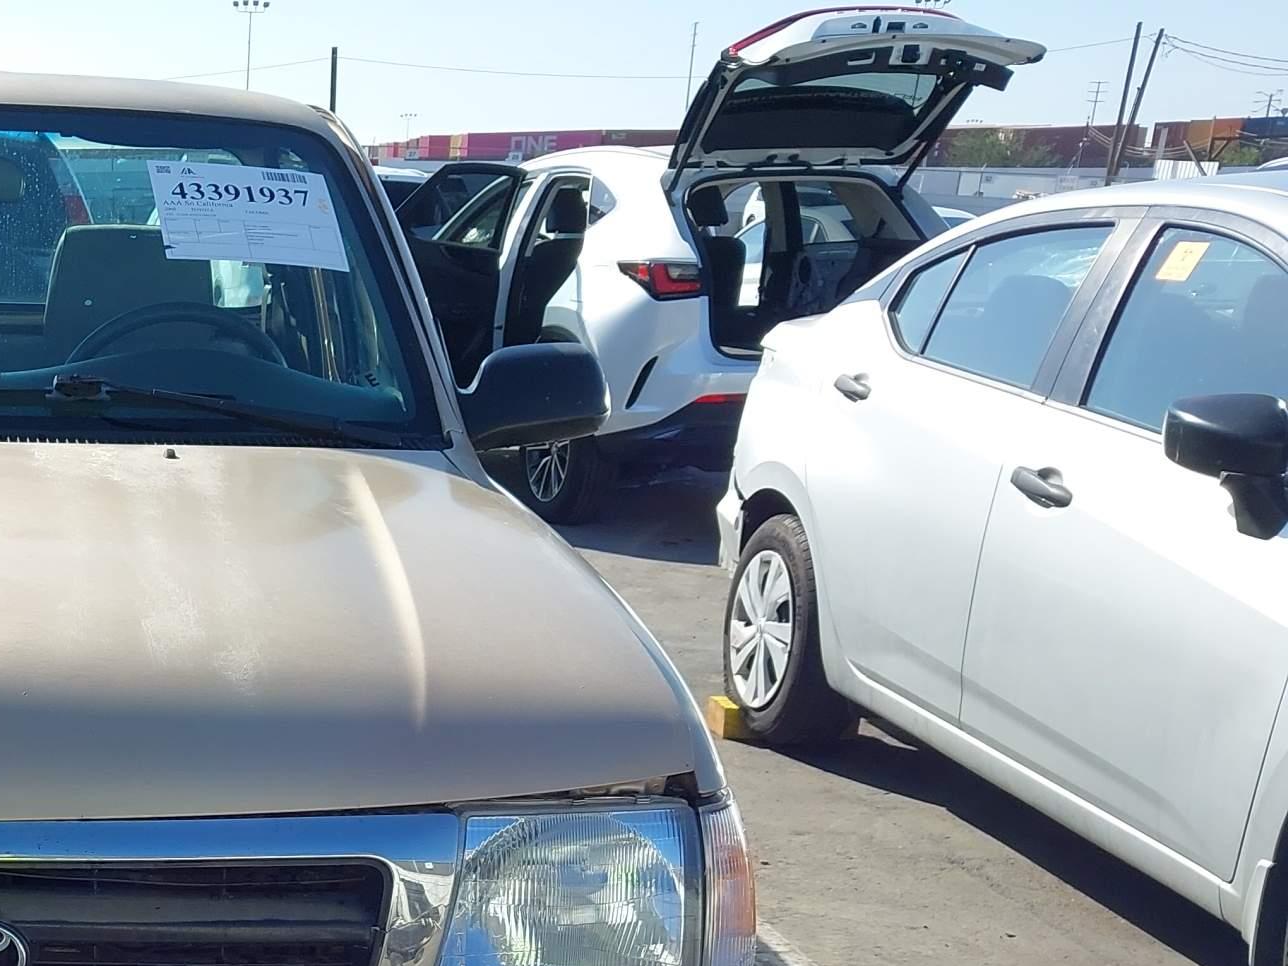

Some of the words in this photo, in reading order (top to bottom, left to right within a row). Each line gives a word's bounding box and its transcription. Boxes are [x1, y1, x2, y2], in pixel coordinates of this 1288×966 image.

[511, 135, 558, 153] ONE
[171, 181, 309, 207] 43391937
[196, 200, 234, 208] California
